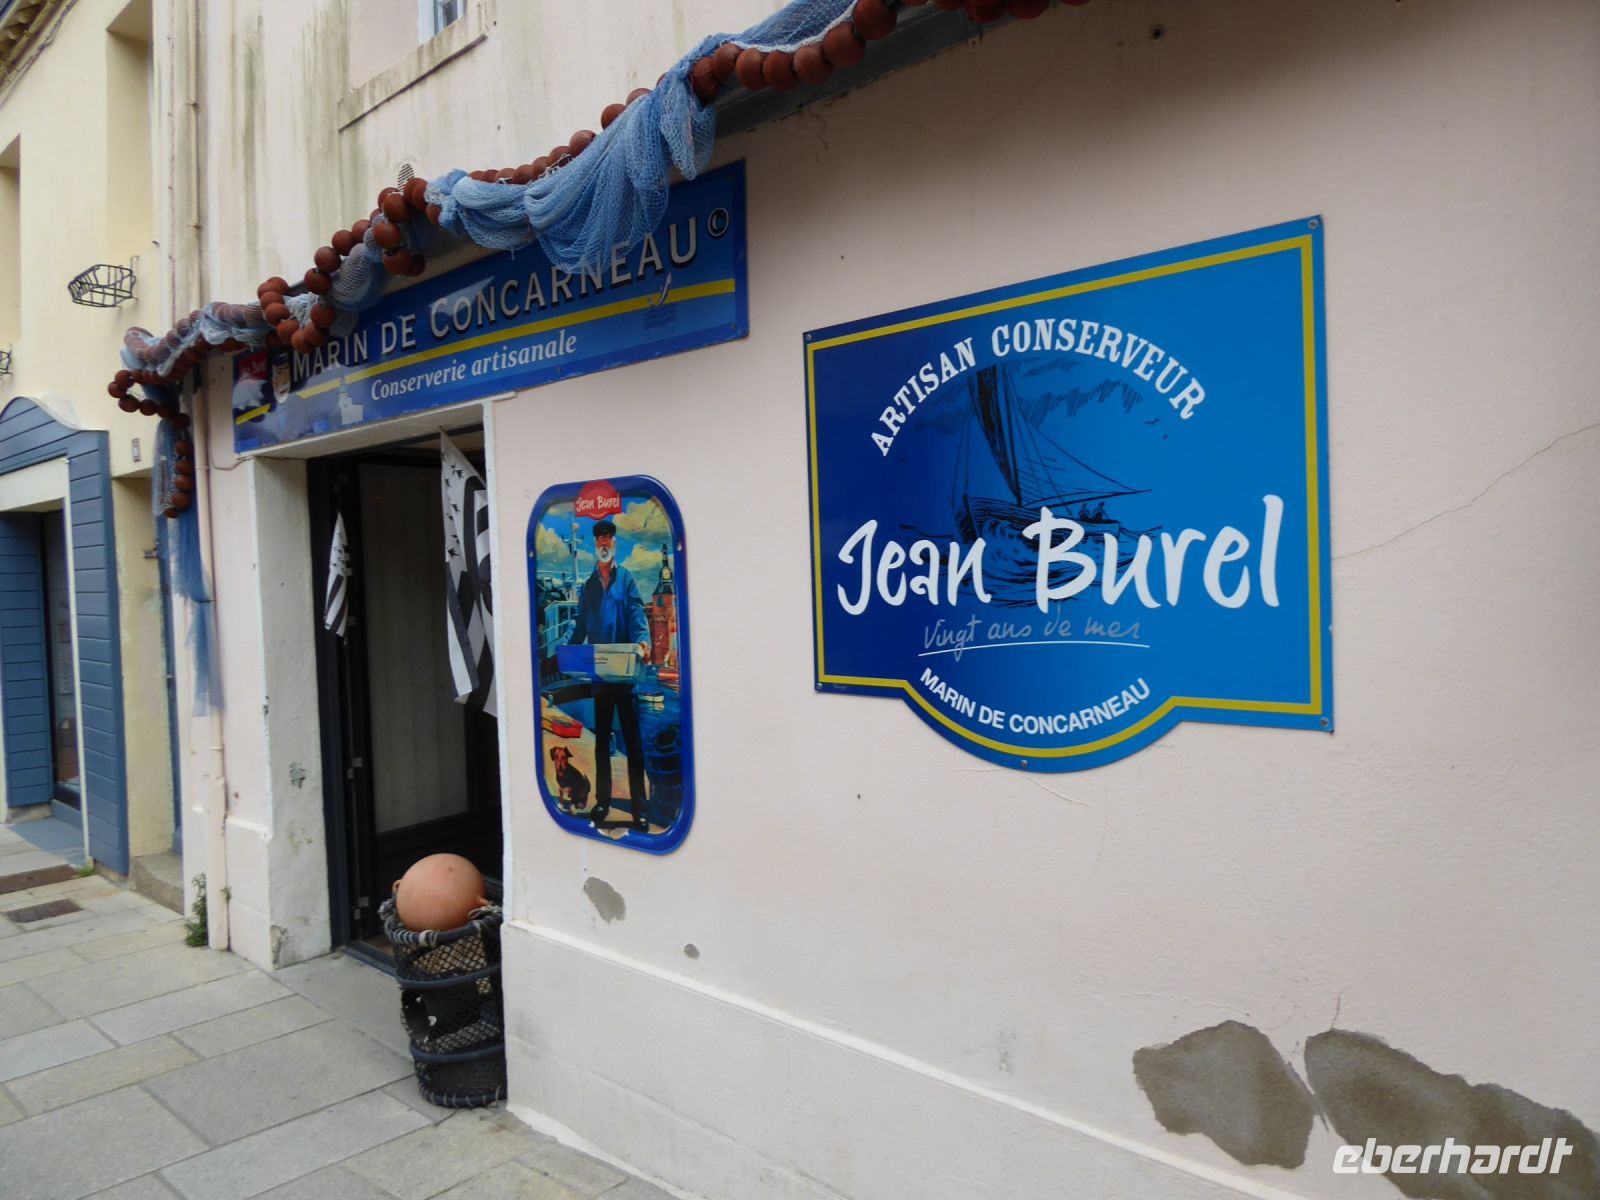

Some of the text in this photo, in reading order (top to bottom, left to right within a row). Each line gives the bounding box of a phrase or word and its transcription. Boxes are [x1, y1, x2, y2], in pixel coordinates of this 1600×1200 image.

[292, 329, 369, 382] MARIN
[381, 313, 417, 355] DE
[430, 215, 698, 339] CONCARNEAU
[371, 328, 578, 401] Conserverie artisanale
[871, 318, 1206, 456] ARTISAN CONSERVEUR
[575, 497, 595, 512] Jean
[837, 494, 1285, 616] Jean Burel
[923, 604, 1141, 662] Vingt ans de mer
[919, 667, 1151, 735] MARIN DE CONCARNEAU
